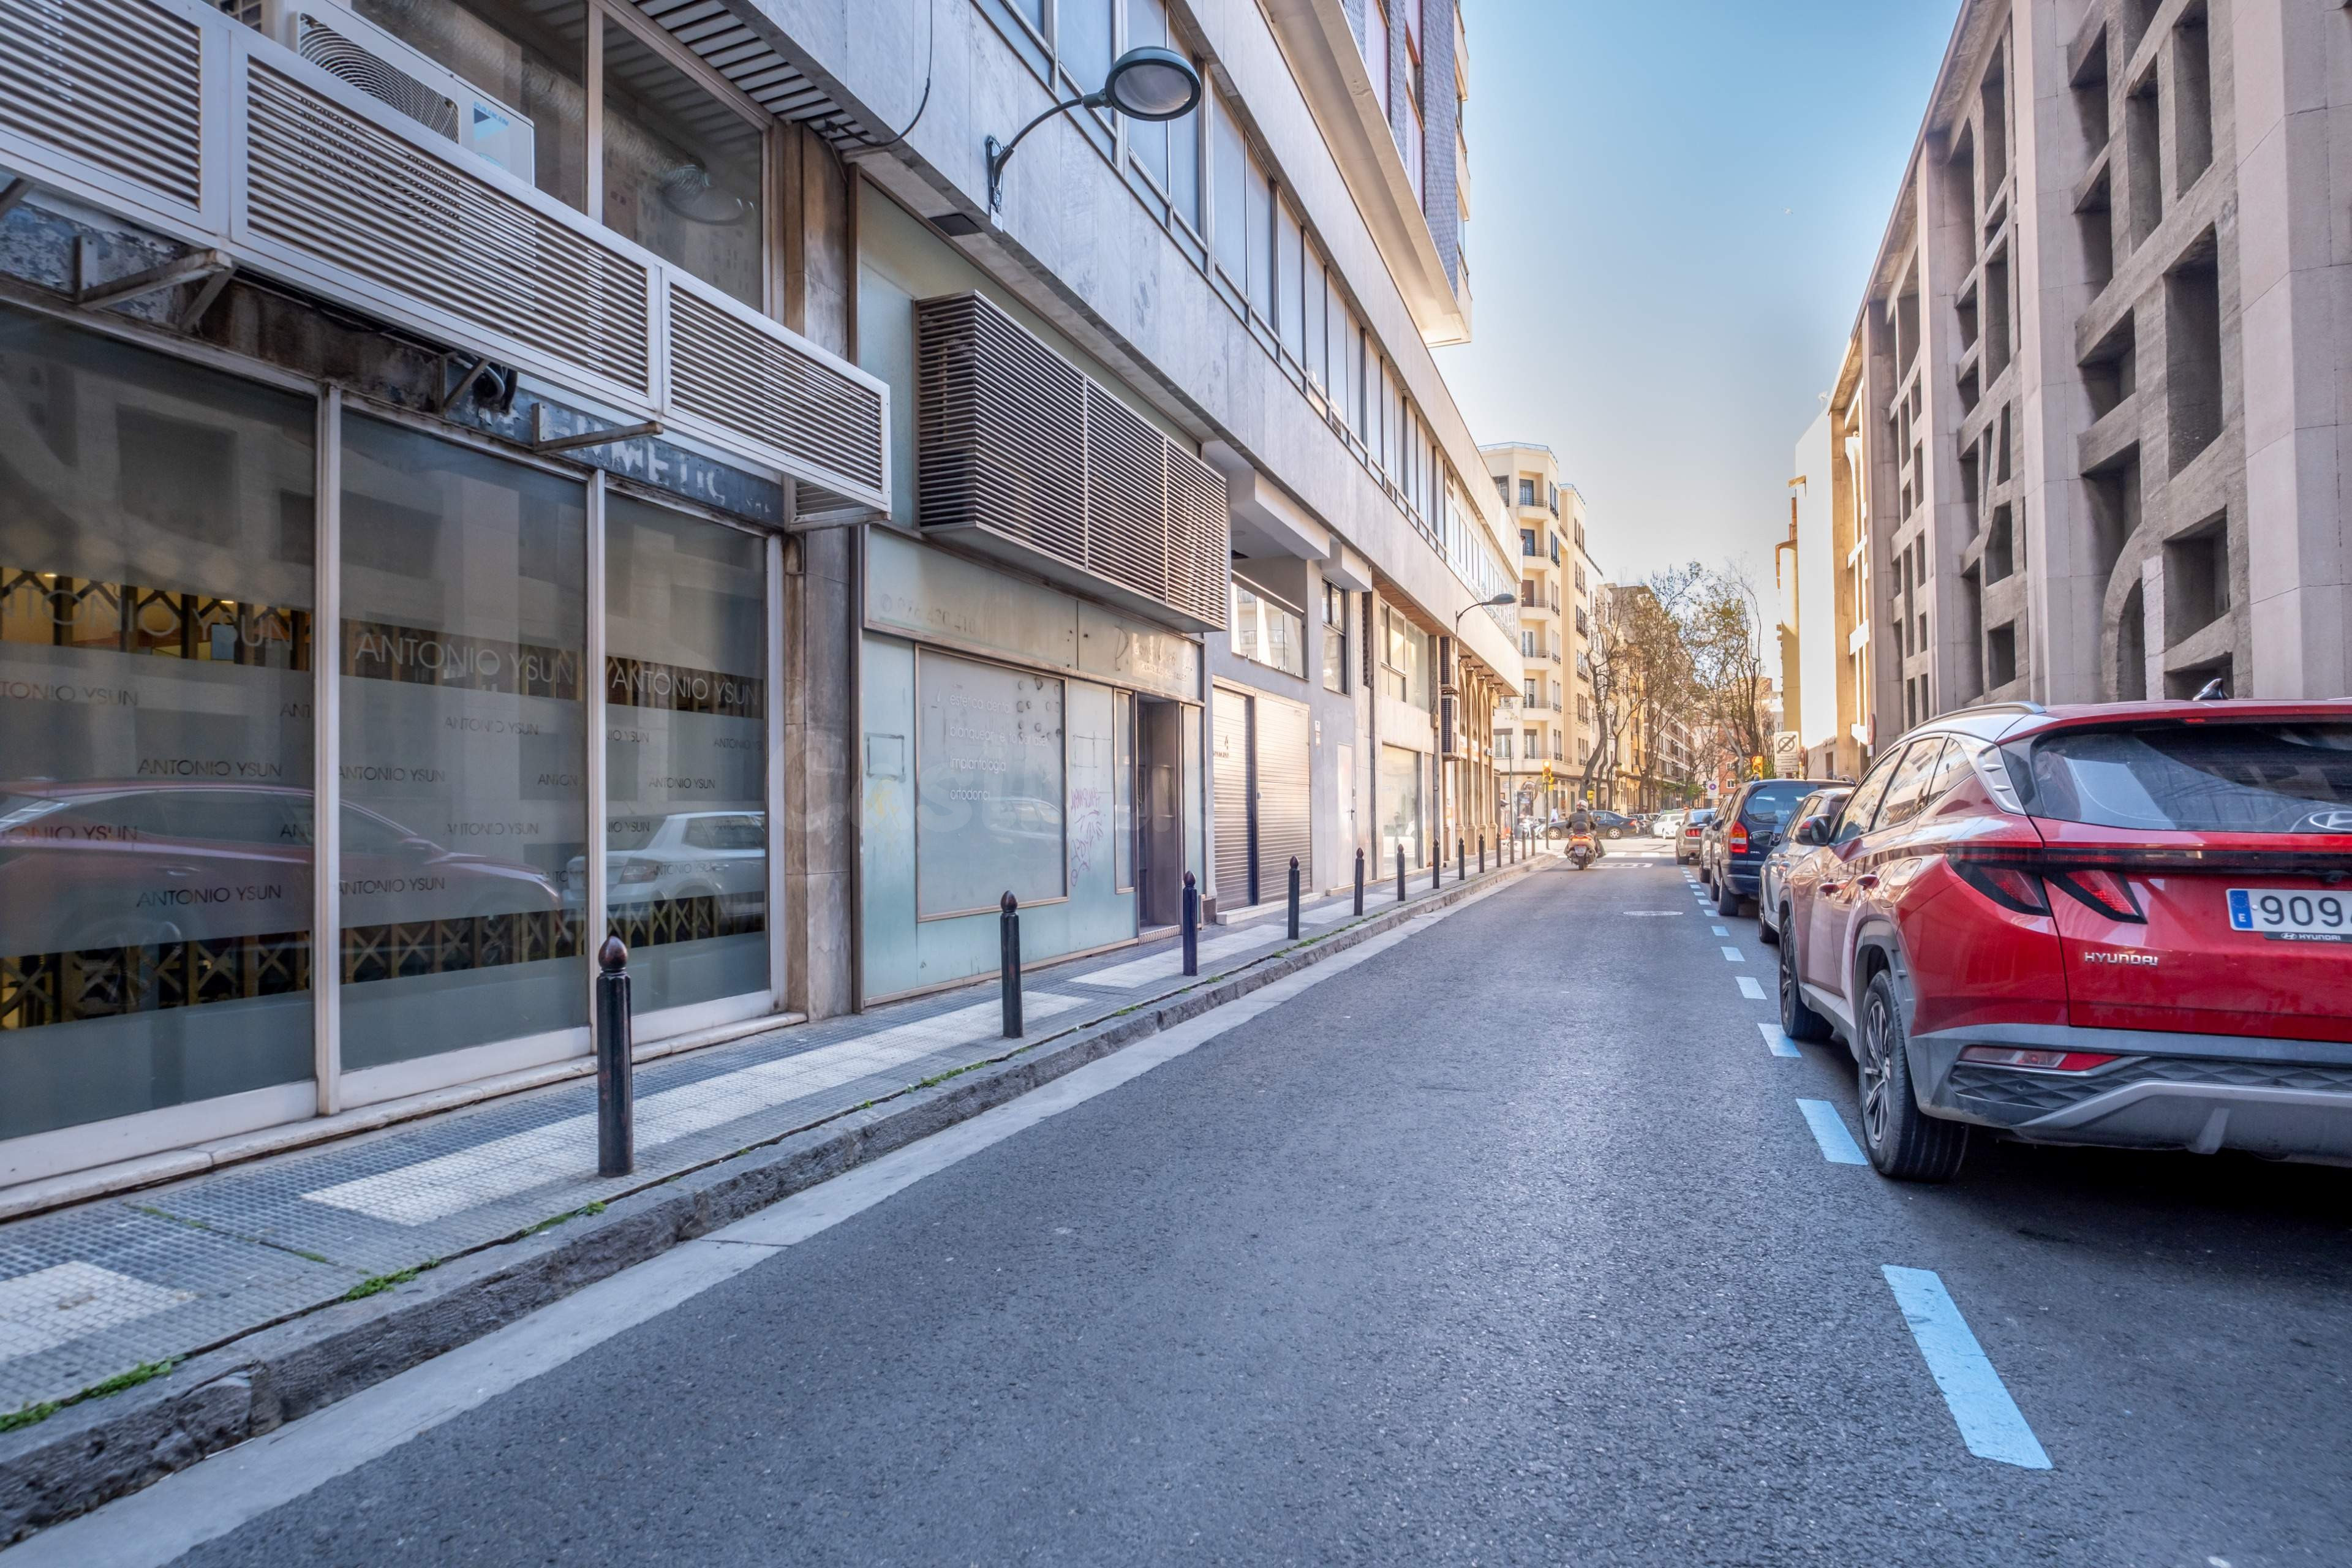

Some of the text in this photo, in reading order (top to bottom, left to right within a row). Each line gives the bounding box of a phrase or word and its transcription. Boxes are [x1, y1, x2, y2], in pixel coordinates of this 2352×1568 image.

[355, 632, 573, 685] ANTONIO YSUN
[612, 666, 758, 705] ANTONIO YSUN
[83, 687, 138, 707] YSUN
[137, 758, 282, 778] ANTONIO YSUN
[410, 769, 445, 783] YSUN
[648, 777, 715, 789] ANTONIO YSUN
[409, 876, 445, 892] YSUN
[136, 884, 281, 908] ANTONIO YSUN
[2260, 895, 2352, 927] 909
[2084, 952, 2158, 966] HYUNDAI
